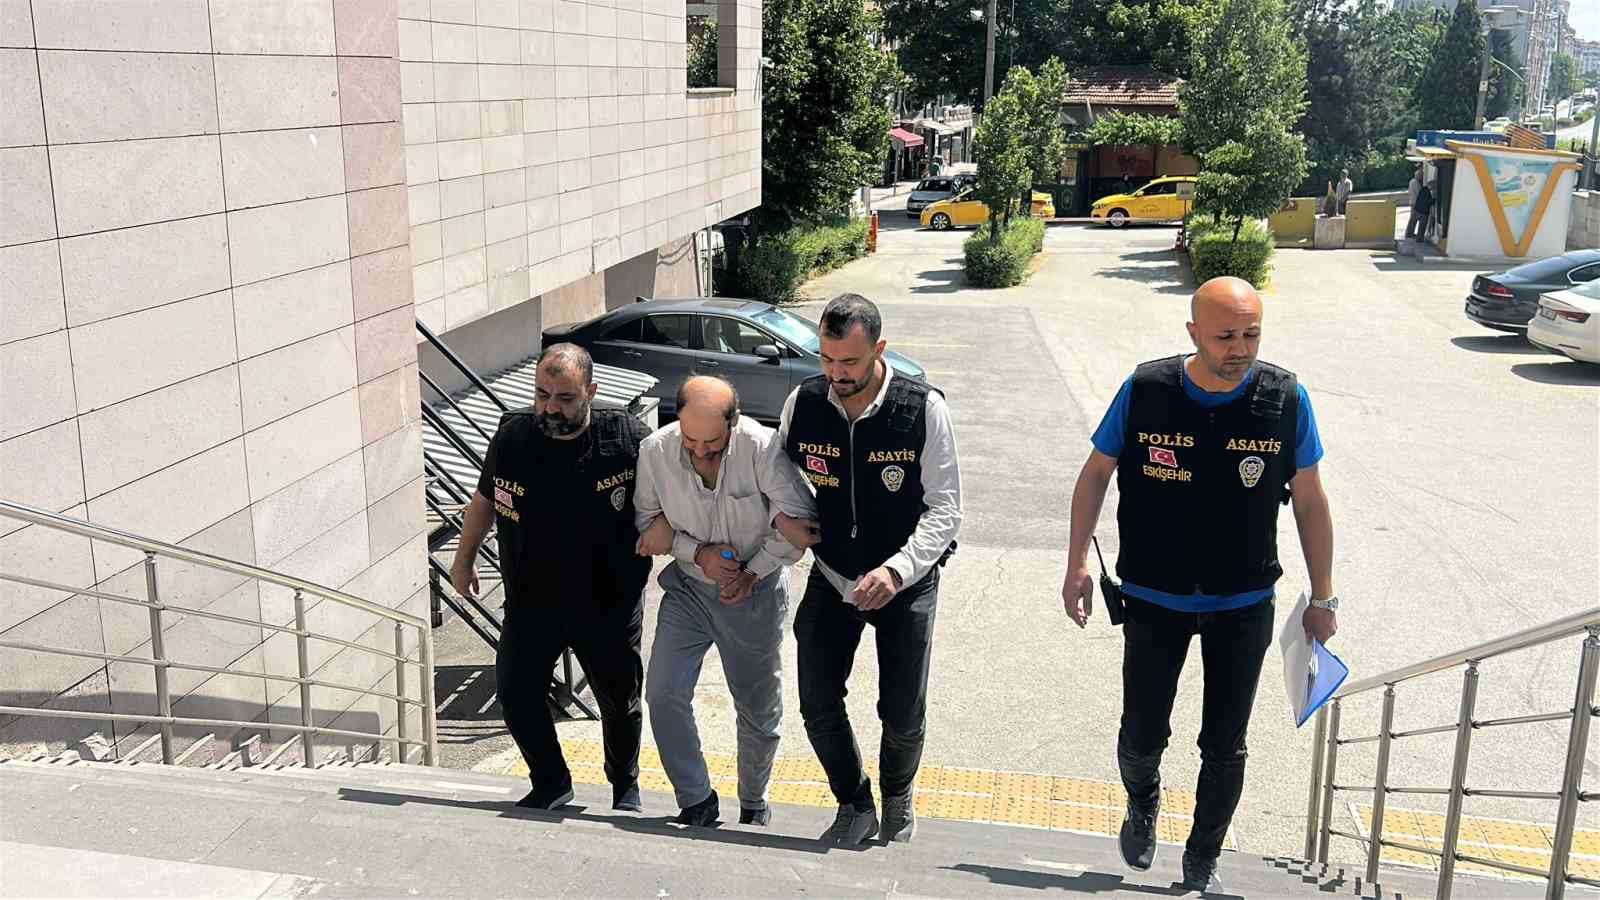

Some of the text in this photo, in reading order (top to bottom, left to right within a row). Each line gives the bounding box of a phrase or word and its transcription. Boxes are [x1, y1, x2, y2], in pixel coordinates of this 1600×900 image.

[1138, 432, 1194, 447] POLİS
[1226, 437, 1282, 455] ASAYİŞ
[798, 443, 841, 457] POLİS
[867, 448, 915, 462] ASAYİŞ
[1142, 465, 1192, 481] ESKİŞEHİR
[493, 475, 526, 497] OLİS
